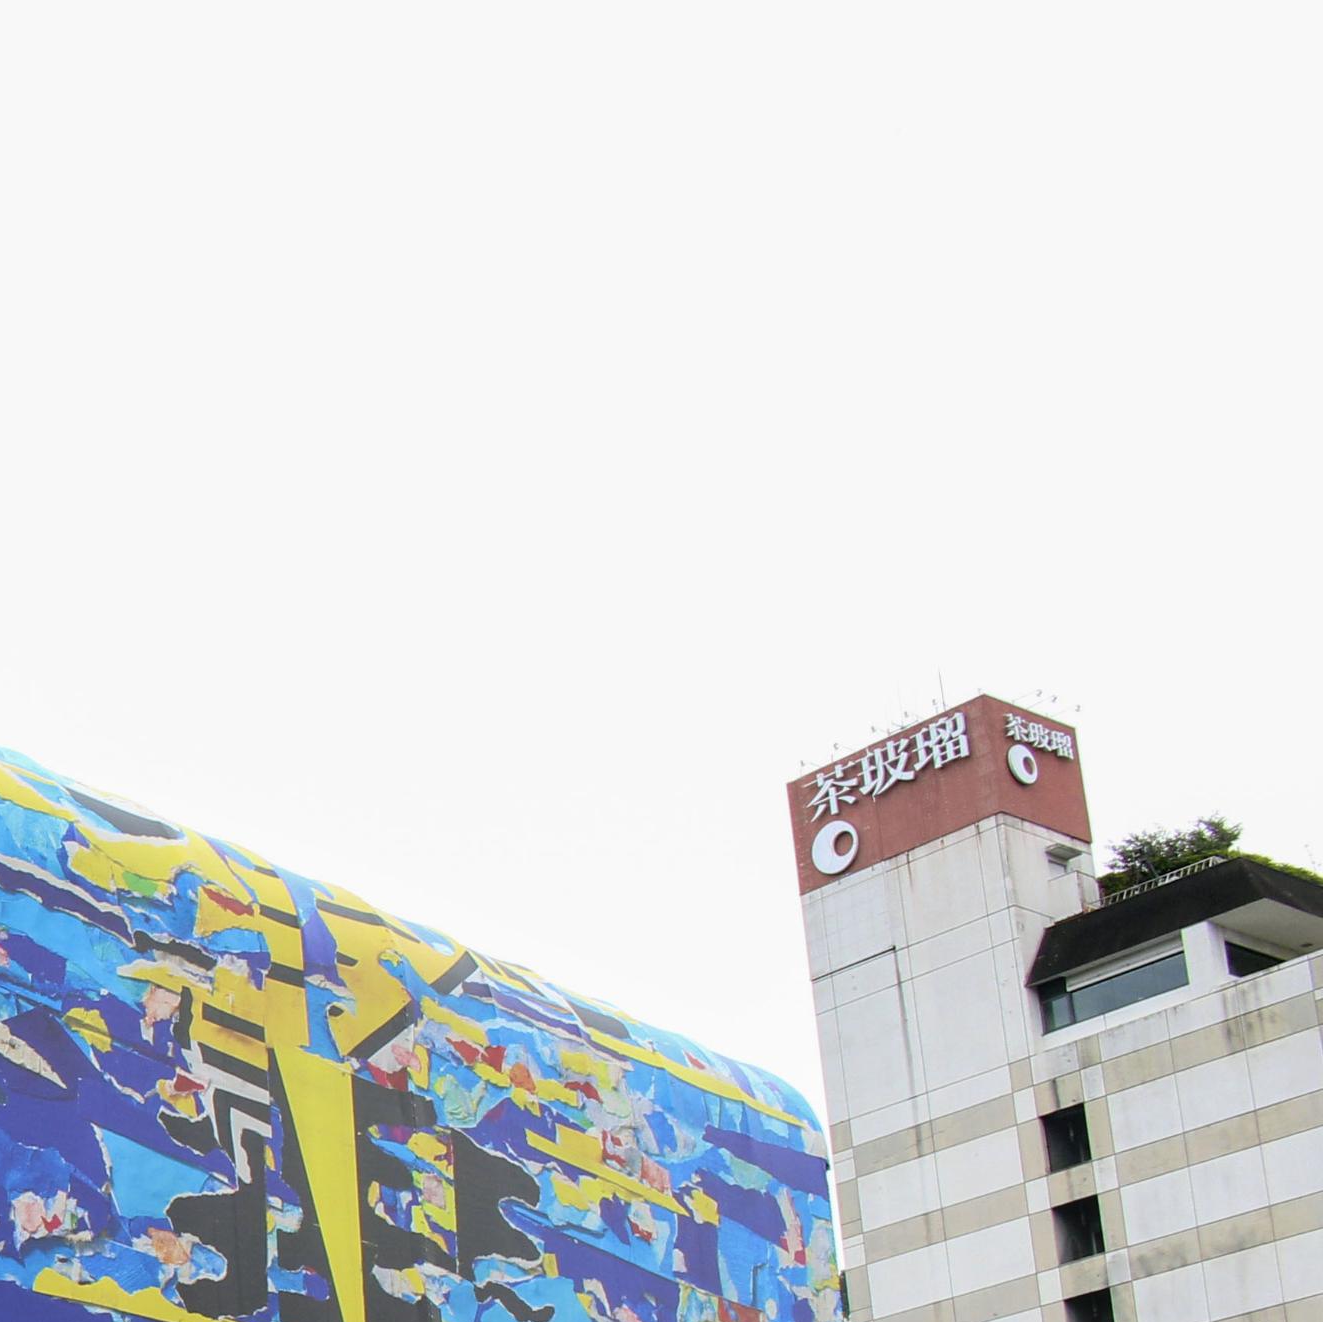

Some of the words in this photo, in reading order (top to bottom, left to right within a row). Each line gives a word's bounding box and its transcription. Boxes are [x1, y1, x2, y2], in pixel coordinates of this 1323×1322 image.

[802, 712, 970, 822] 茶玻瑠
[1003, 713, 1074, 761] 茶玻瑠
